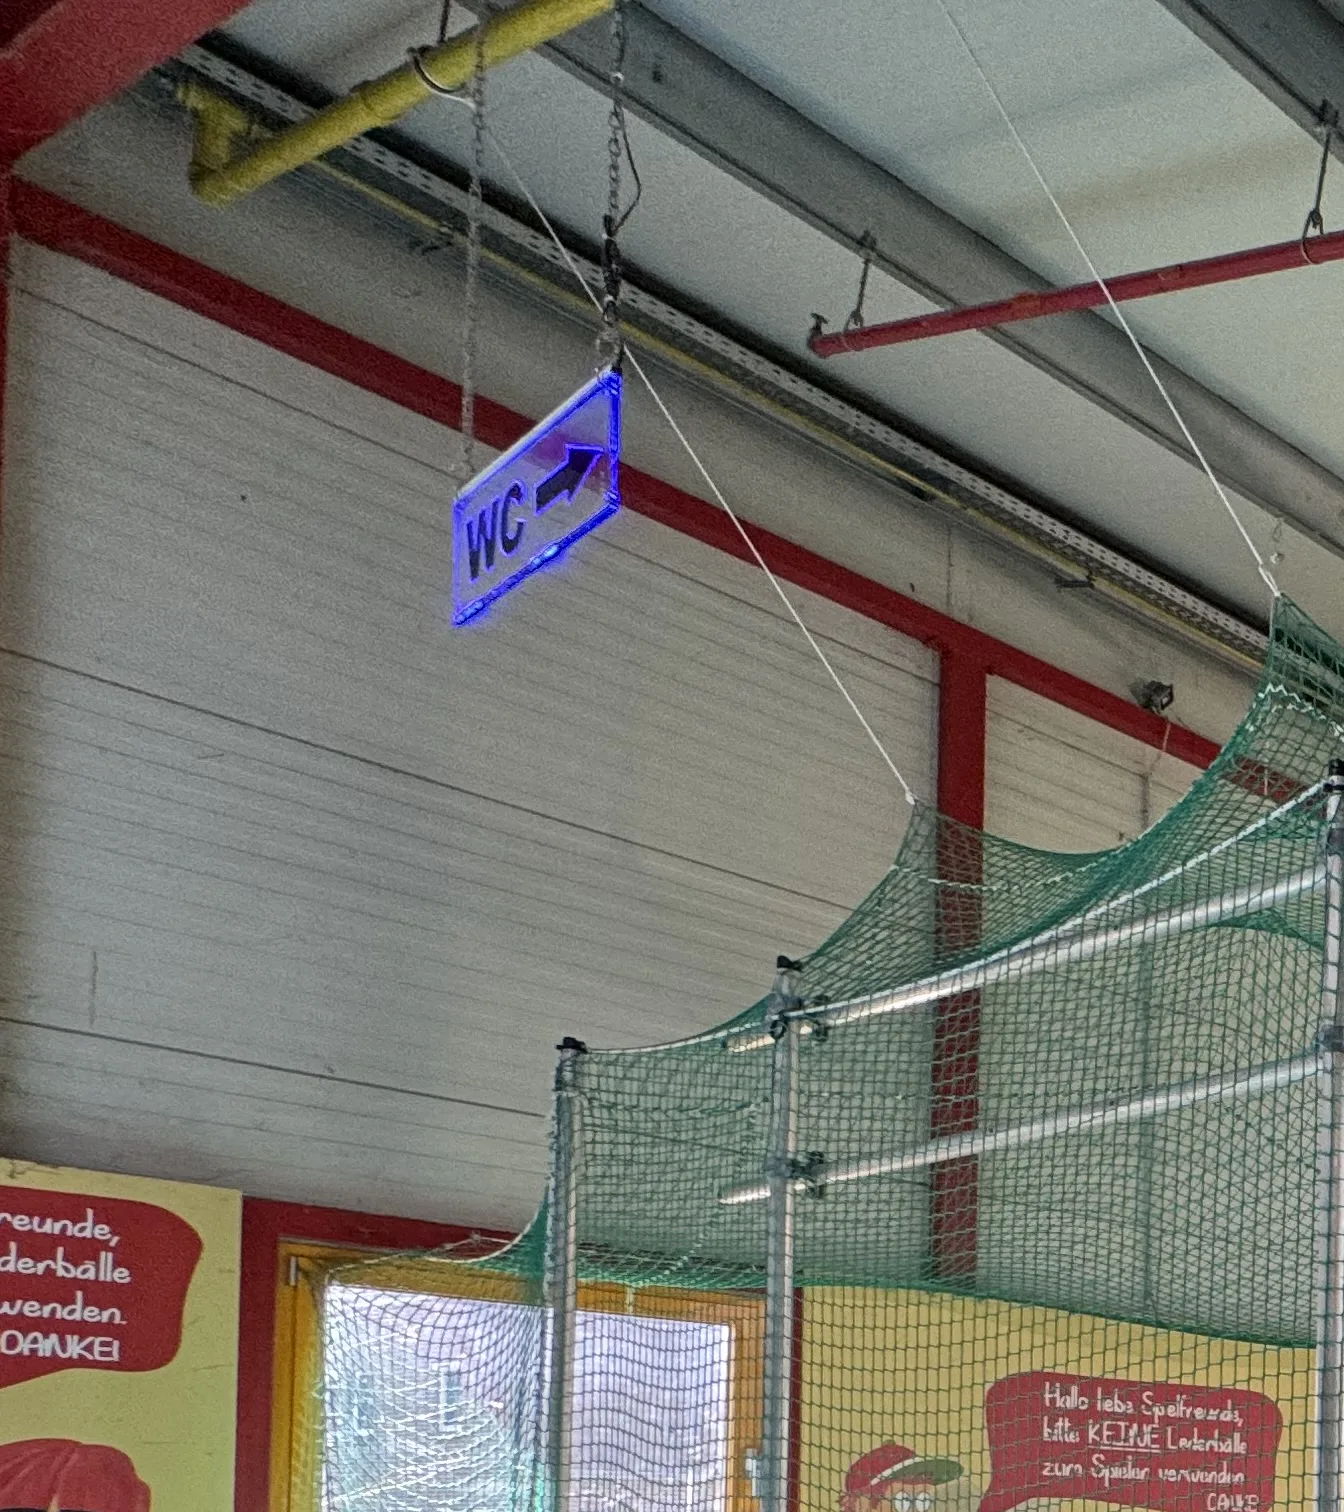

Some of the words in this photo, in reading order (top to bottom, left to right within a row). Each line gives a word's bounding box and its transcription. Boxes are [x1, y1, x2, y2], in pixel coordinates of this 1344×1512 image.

[466, 480, 526, 583] WC
[1096, 1386, 1134, 1414] lebe
[1087, 1419, 1160, 1449] KEINE
